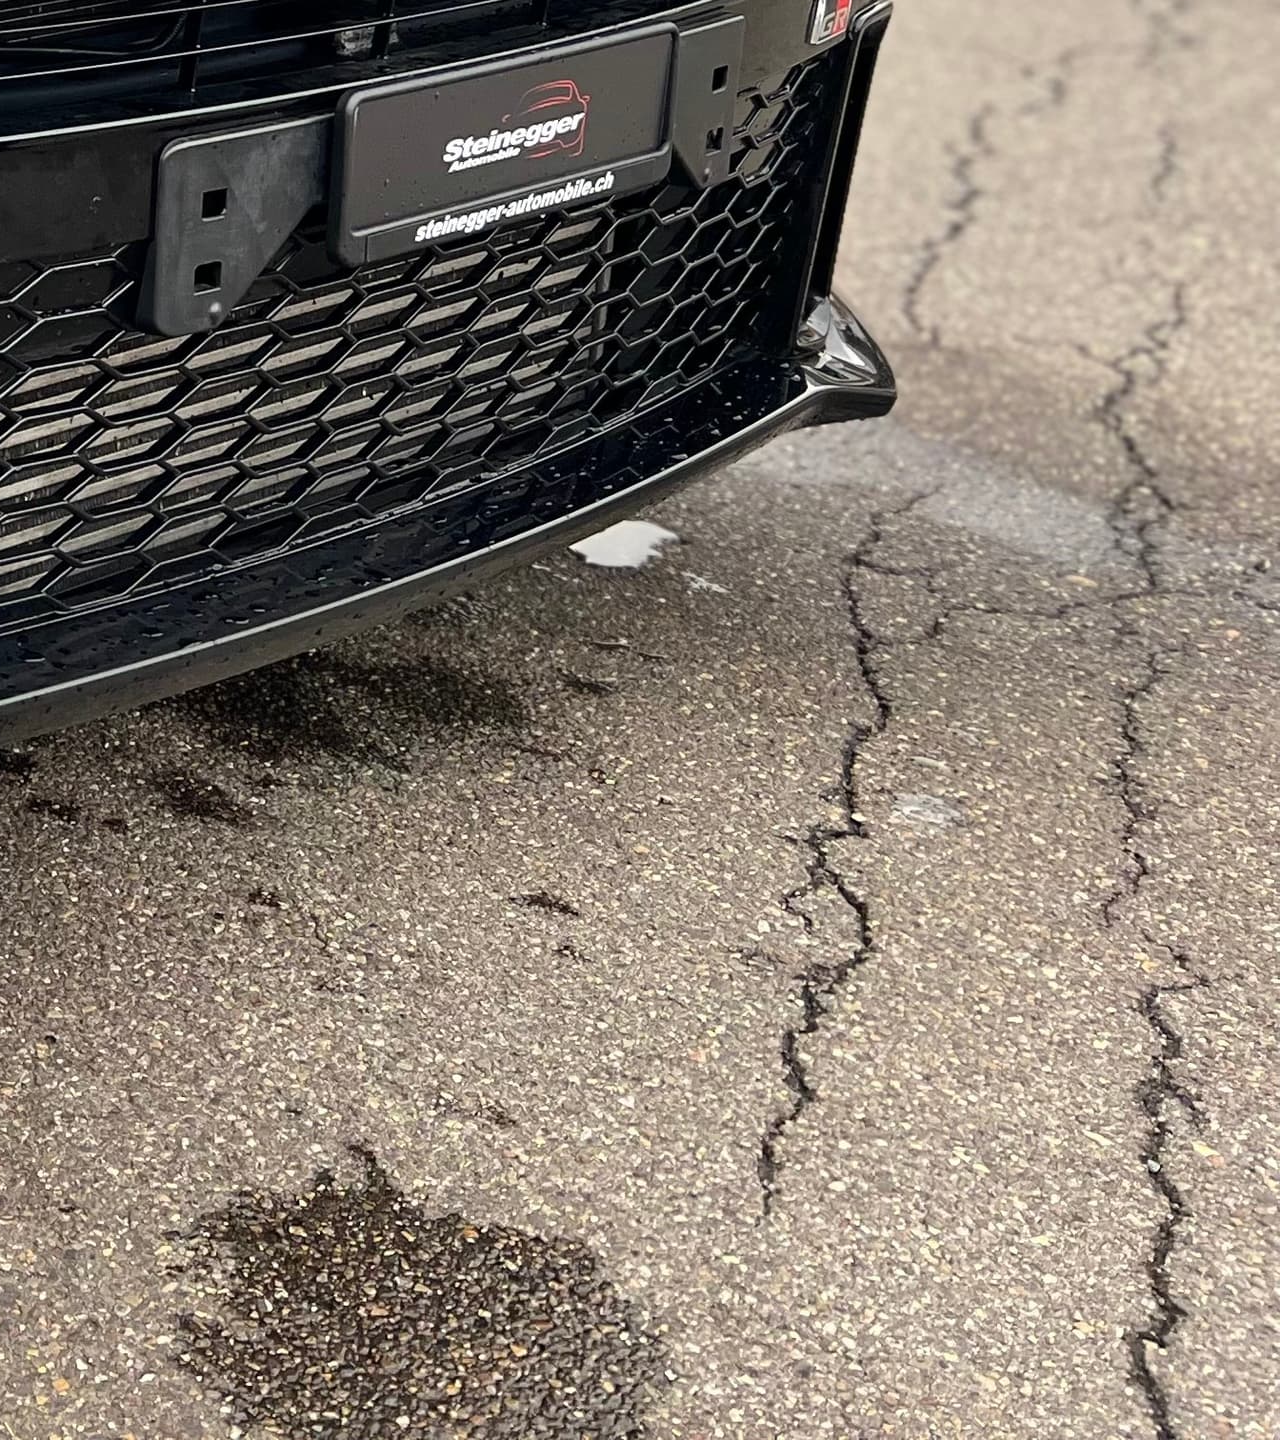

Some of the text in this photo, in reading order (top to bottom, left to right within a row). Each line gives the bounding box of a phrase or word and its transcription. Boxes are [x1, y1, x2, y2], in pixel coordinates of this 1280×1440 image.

[443, 111, 586, 163] Steinegger
[447, 146, 521, 174] Automobile
[414, 171, 616, 243] steinegger-automobile.ch
